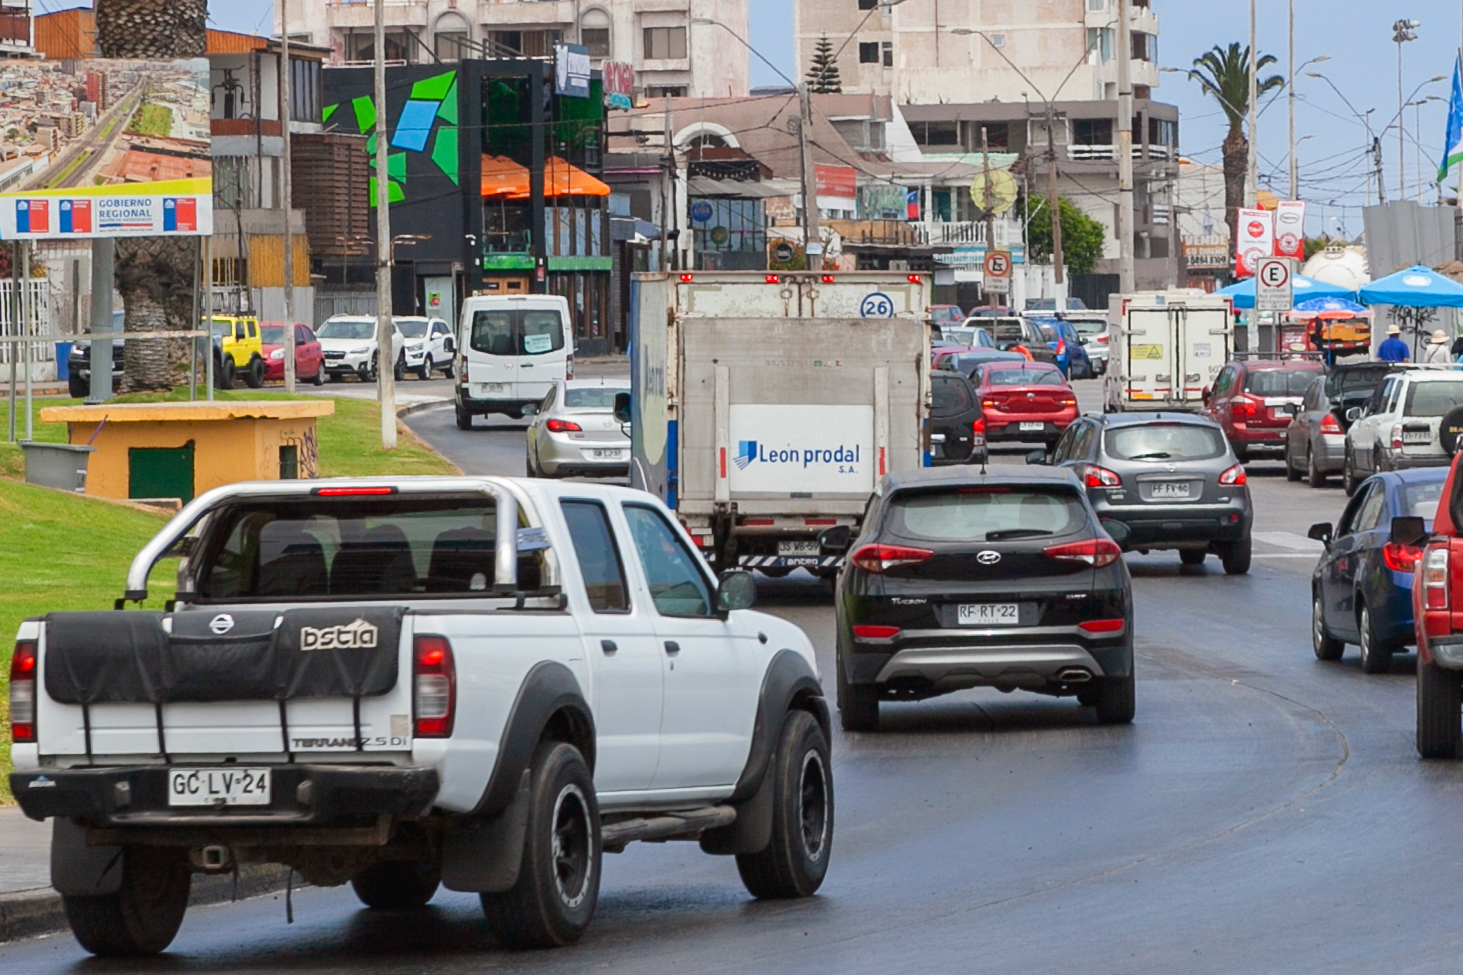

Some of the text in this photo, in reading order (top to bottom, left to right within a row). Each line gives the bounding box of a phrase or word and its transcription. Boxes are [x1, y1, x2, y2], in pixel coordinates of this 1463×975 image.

[99, 199, 152, 207] GOBIERNO
[99, 209, 153, 218] REGIONAL
[1185, 234, 1228, 245] VENDE
[992, 258, 1003, 272] E
[1270, 268, 1279, 281] E
[865, 301, 888, 315] 26
[760, 445, 860, 468] Leon prodal
[839, 466, 859, 474] S.A.
